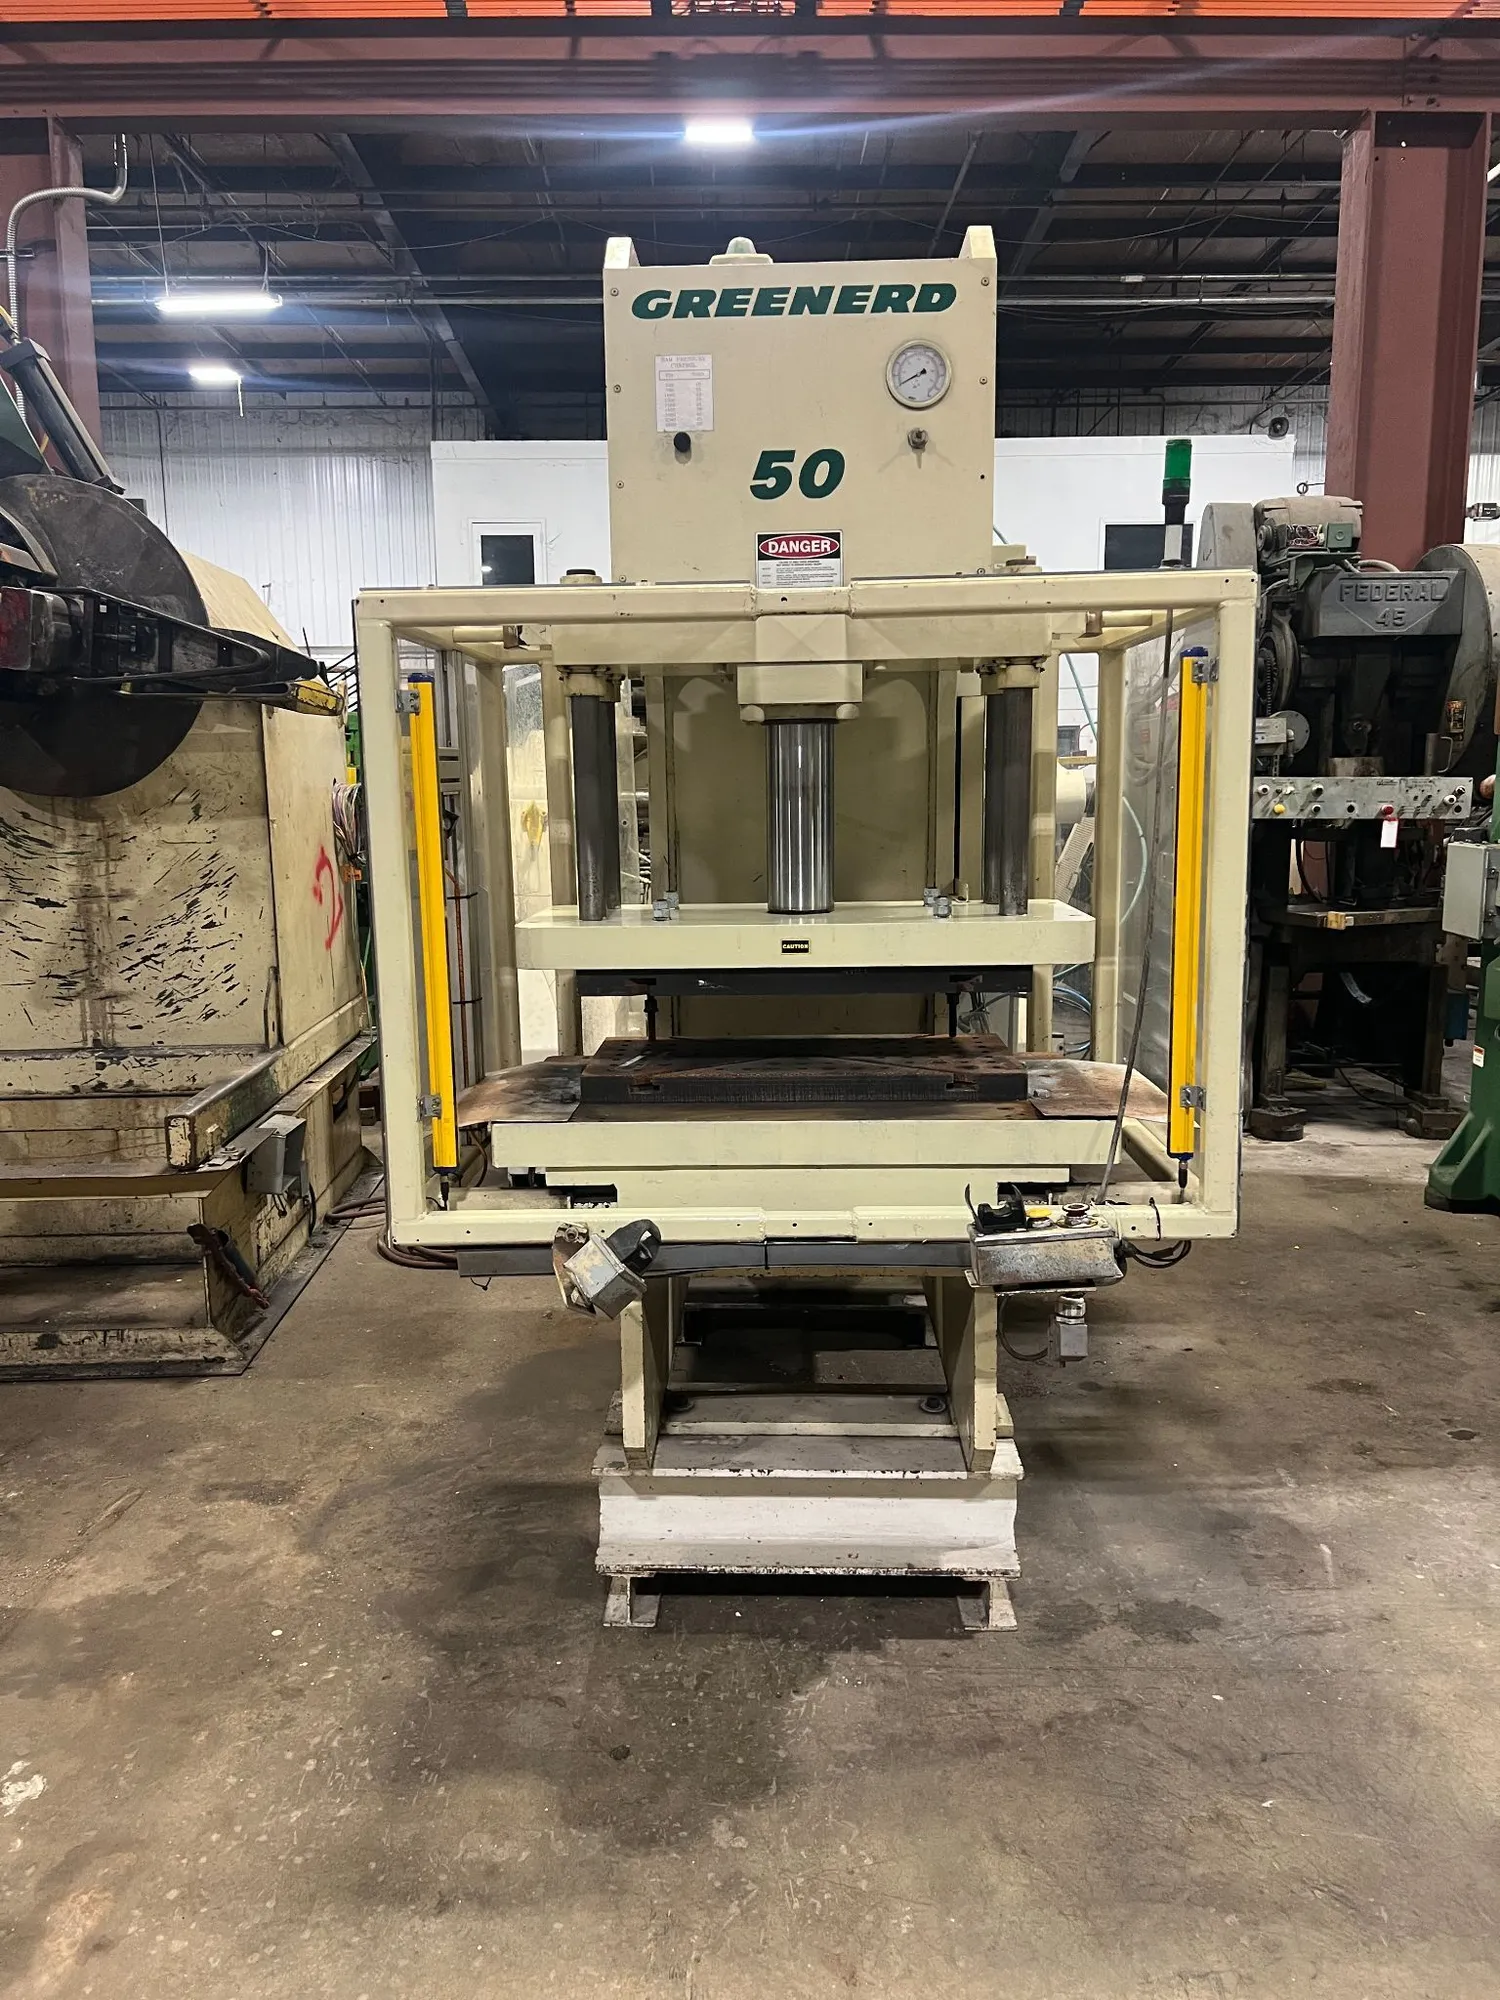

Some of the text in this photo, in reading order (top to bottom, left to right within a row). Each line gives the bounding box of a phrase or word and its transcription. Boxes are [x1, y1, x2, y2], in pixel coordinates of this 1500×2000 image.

[631, 282, 957, 320] GREENERD
[749, 448, 846, 500] 50
[767, 539, 831, 554] DANGER
[1340, 582, 1446, 602] FEDERAL
